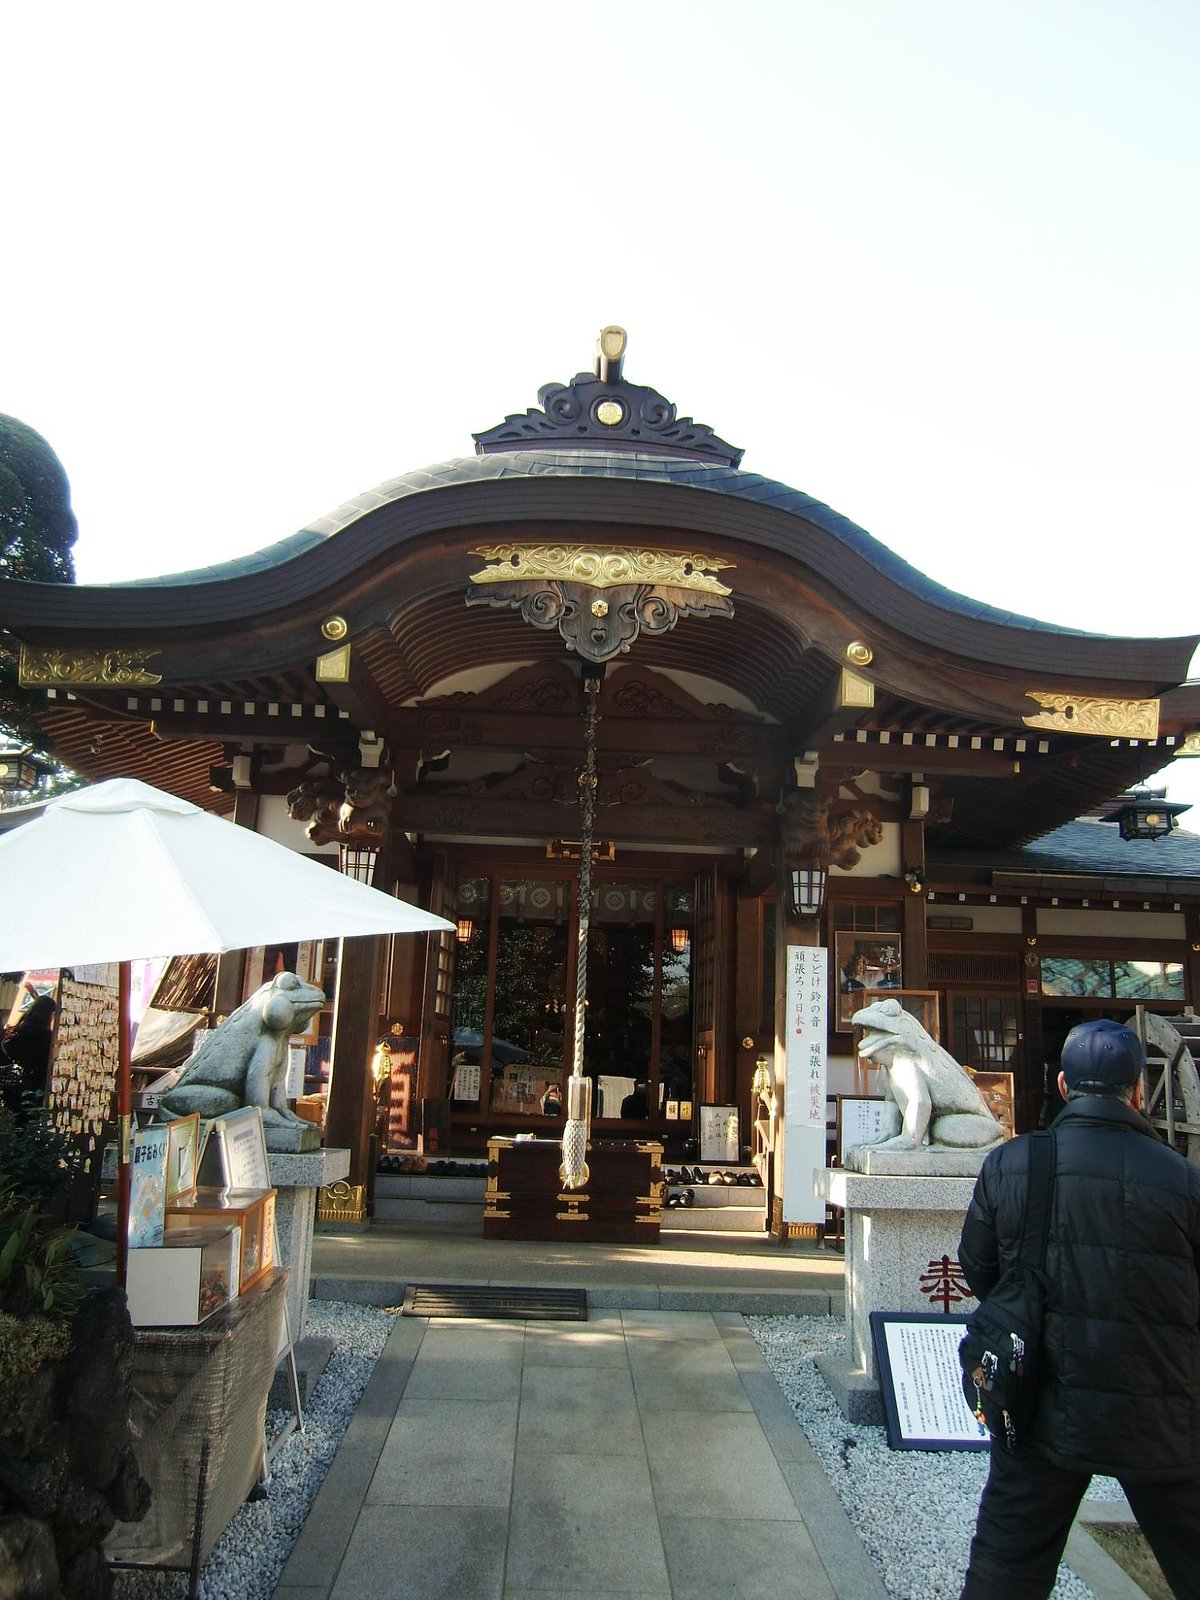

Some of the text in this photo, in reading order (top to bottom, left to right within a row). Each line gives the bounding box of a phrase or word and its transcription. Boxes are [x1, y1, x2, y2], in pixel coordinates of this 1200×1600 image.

[794, 951, 806, 1027] 頑張ろう日本
[810, 952, 822, 1028] とどけ鈴の音
[919, 1254, 974, 1314] 奉
